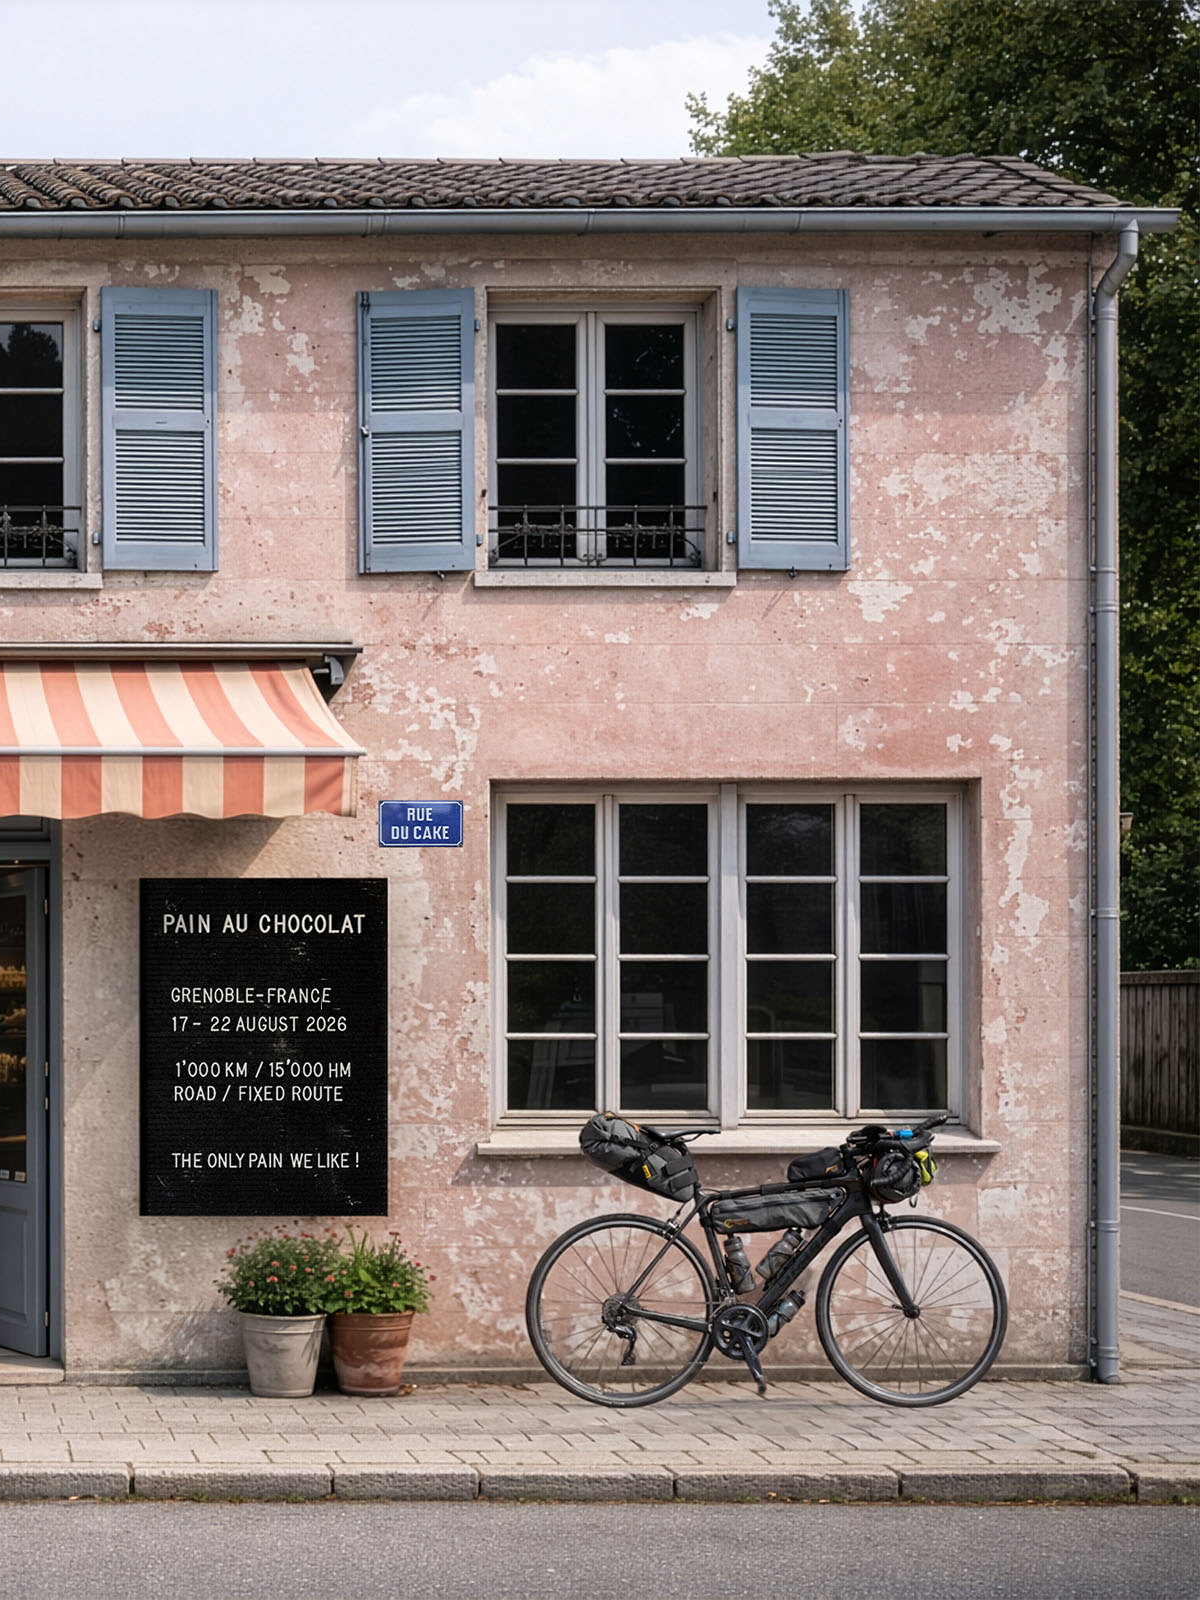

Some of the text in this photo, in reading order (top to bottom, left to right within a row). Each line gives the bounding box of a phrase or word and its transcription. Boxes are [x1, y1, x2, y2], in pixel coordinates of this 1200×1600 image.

[407, 807, 433, 822] RUE
[391, 825, 450, 840] DU CAKE
[163, 913, 366, 934] PAIN AU CHOCOLAT
[210, 1016, 231, 1032] 22
[236, 1016, 299, 1032] AUGUST
[306, 1016, 347, 1032] 2026
[225, 1062, 248, 1078] KM
[328, 1062, 351, 1078] HM
[174, 1085, 217, 1102] ROAD
[238, 1085, 285, 1102] FIXED
[292, 1085, 343, 1102] ROUTE
[171, 1152, 203, 1169] THE
[207, 1152, 245, 1169] ONLY
[248, 1152, 283, 1169] PAIN
[290, 1152, 313, 1169] WE
[317, 1152, 350, 1169] LIKE
